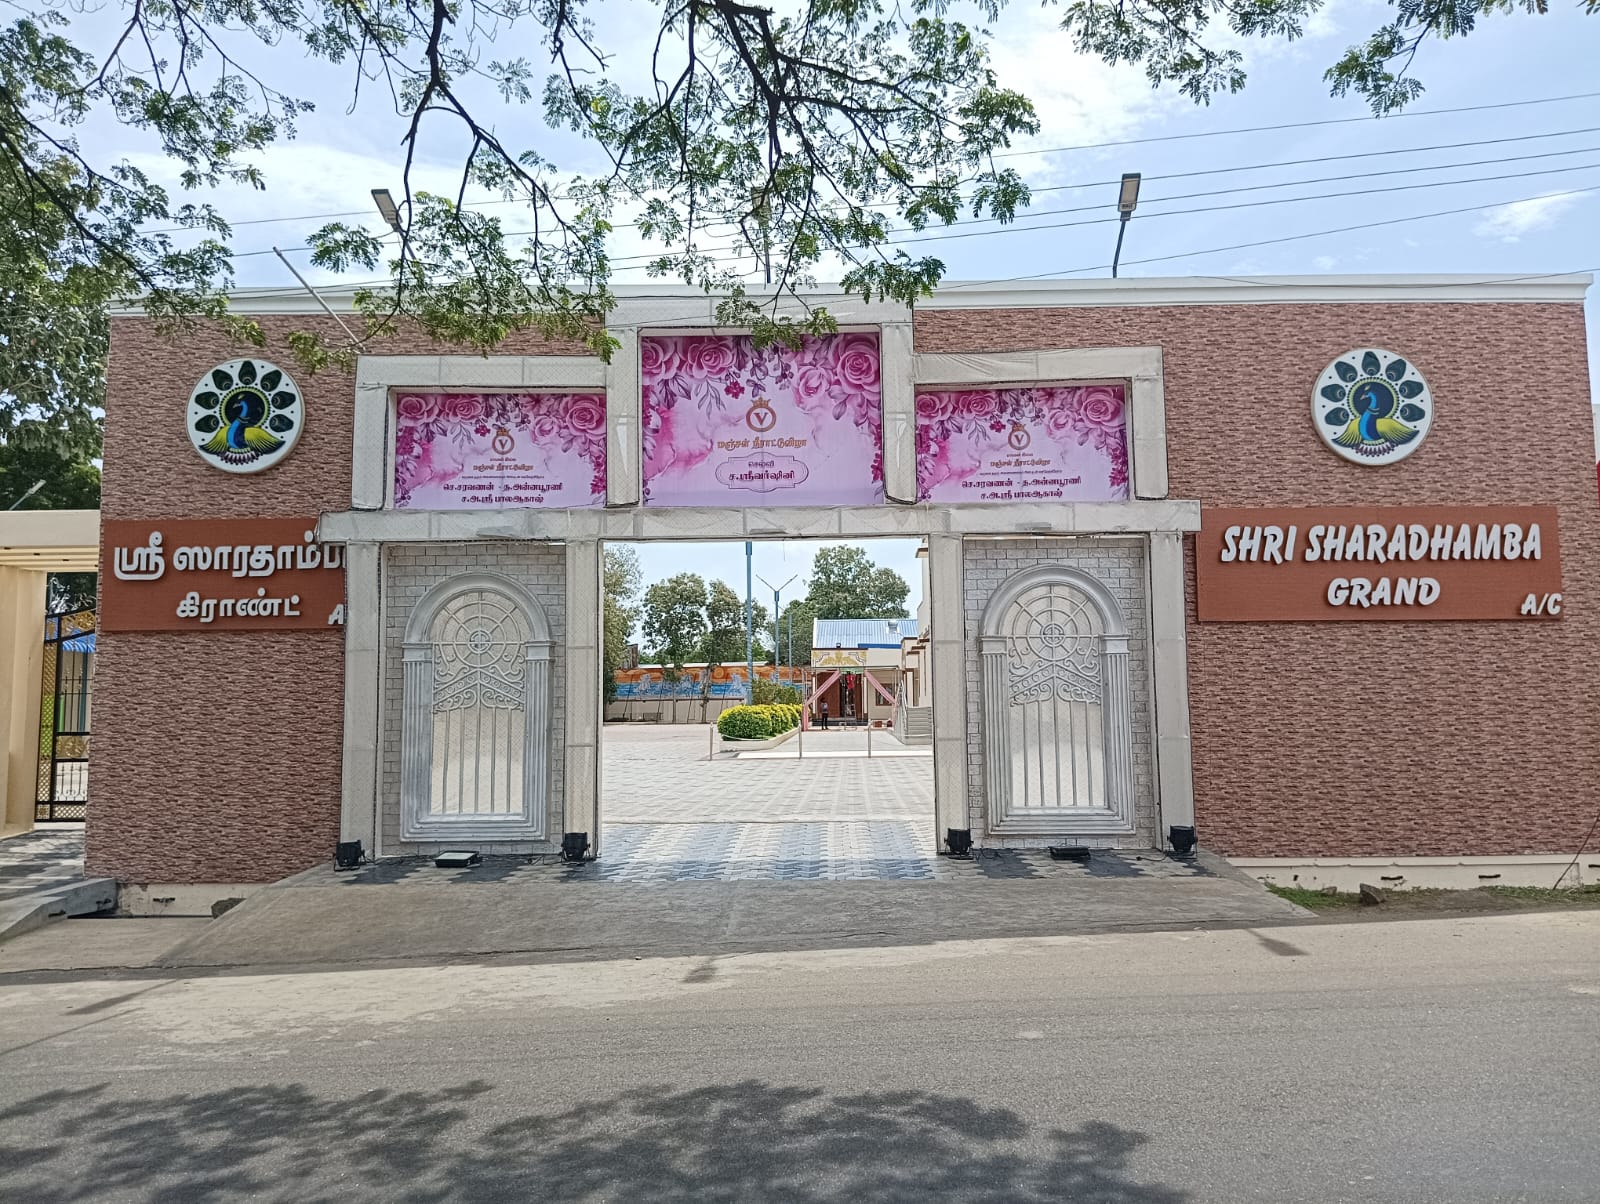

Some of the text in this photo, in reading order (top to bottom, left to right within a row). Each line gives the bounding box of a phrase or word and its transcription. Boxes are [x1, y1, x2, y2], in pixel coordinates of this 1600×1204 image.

[754, 412, 768, 425] V
[717, 438, 750, 452] மஞ்சள்
[172, 530, 346, 578] ஸாரதாம்ப
[1221, 523, 1542, 565] SHRI SHARADHAMBA
[175, 587, 301, 623] கிராண்ட்
[1327, 576, 1441, 609] GRAND
[1520, 592, 1563, 616] A/C
